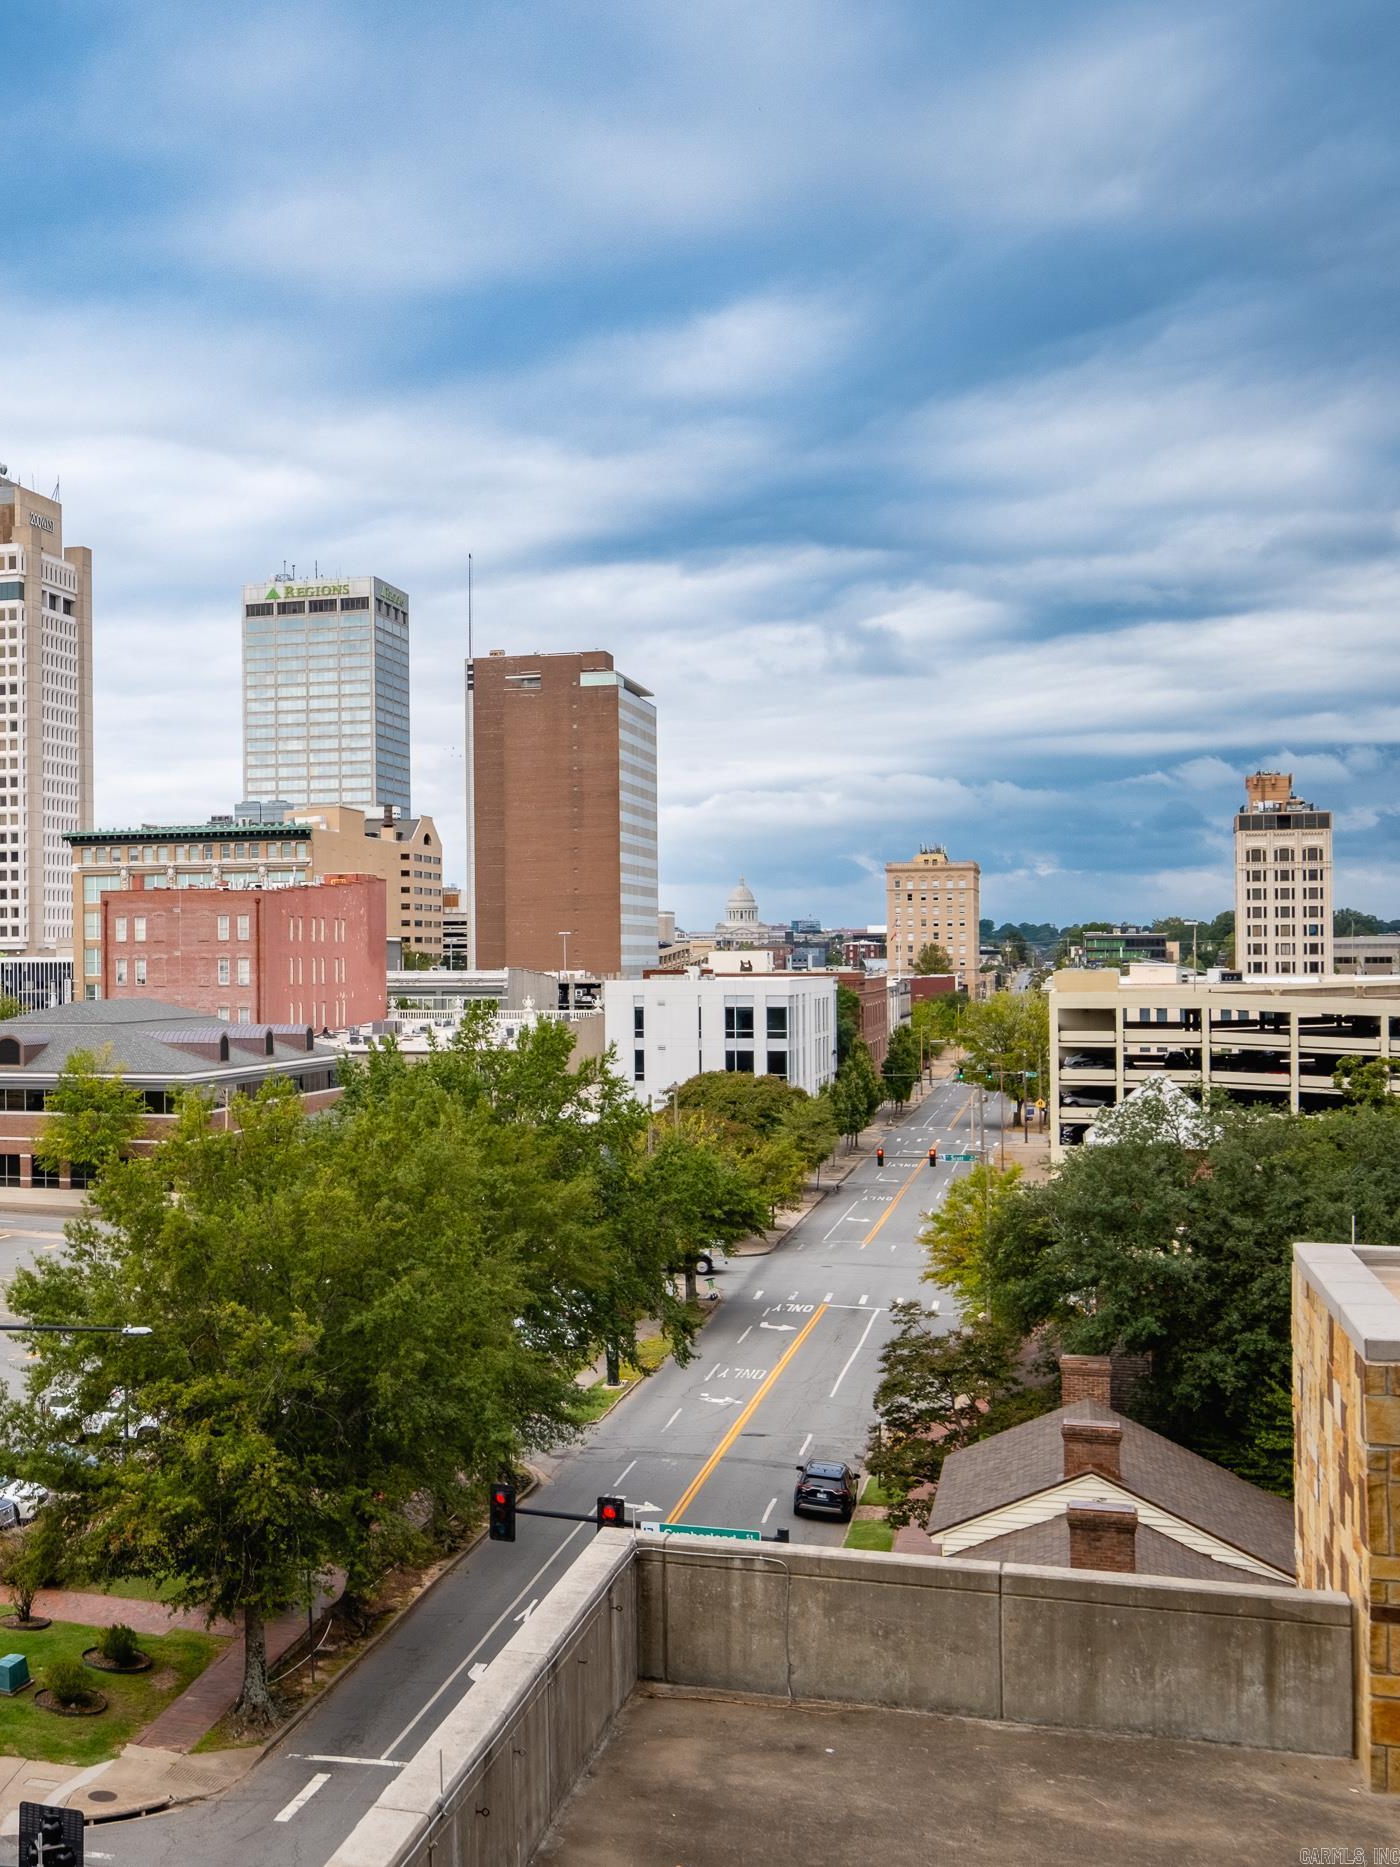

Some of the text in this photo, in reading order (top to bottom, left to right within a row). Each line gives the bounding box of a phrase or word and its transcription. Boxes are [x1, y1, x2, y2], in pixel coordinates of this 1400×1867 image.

[284, 584, 349, 598] REGIONS
[771, 1304, 815, 1313] ONLY
[716, 1368, 768, 1380] ONLY
